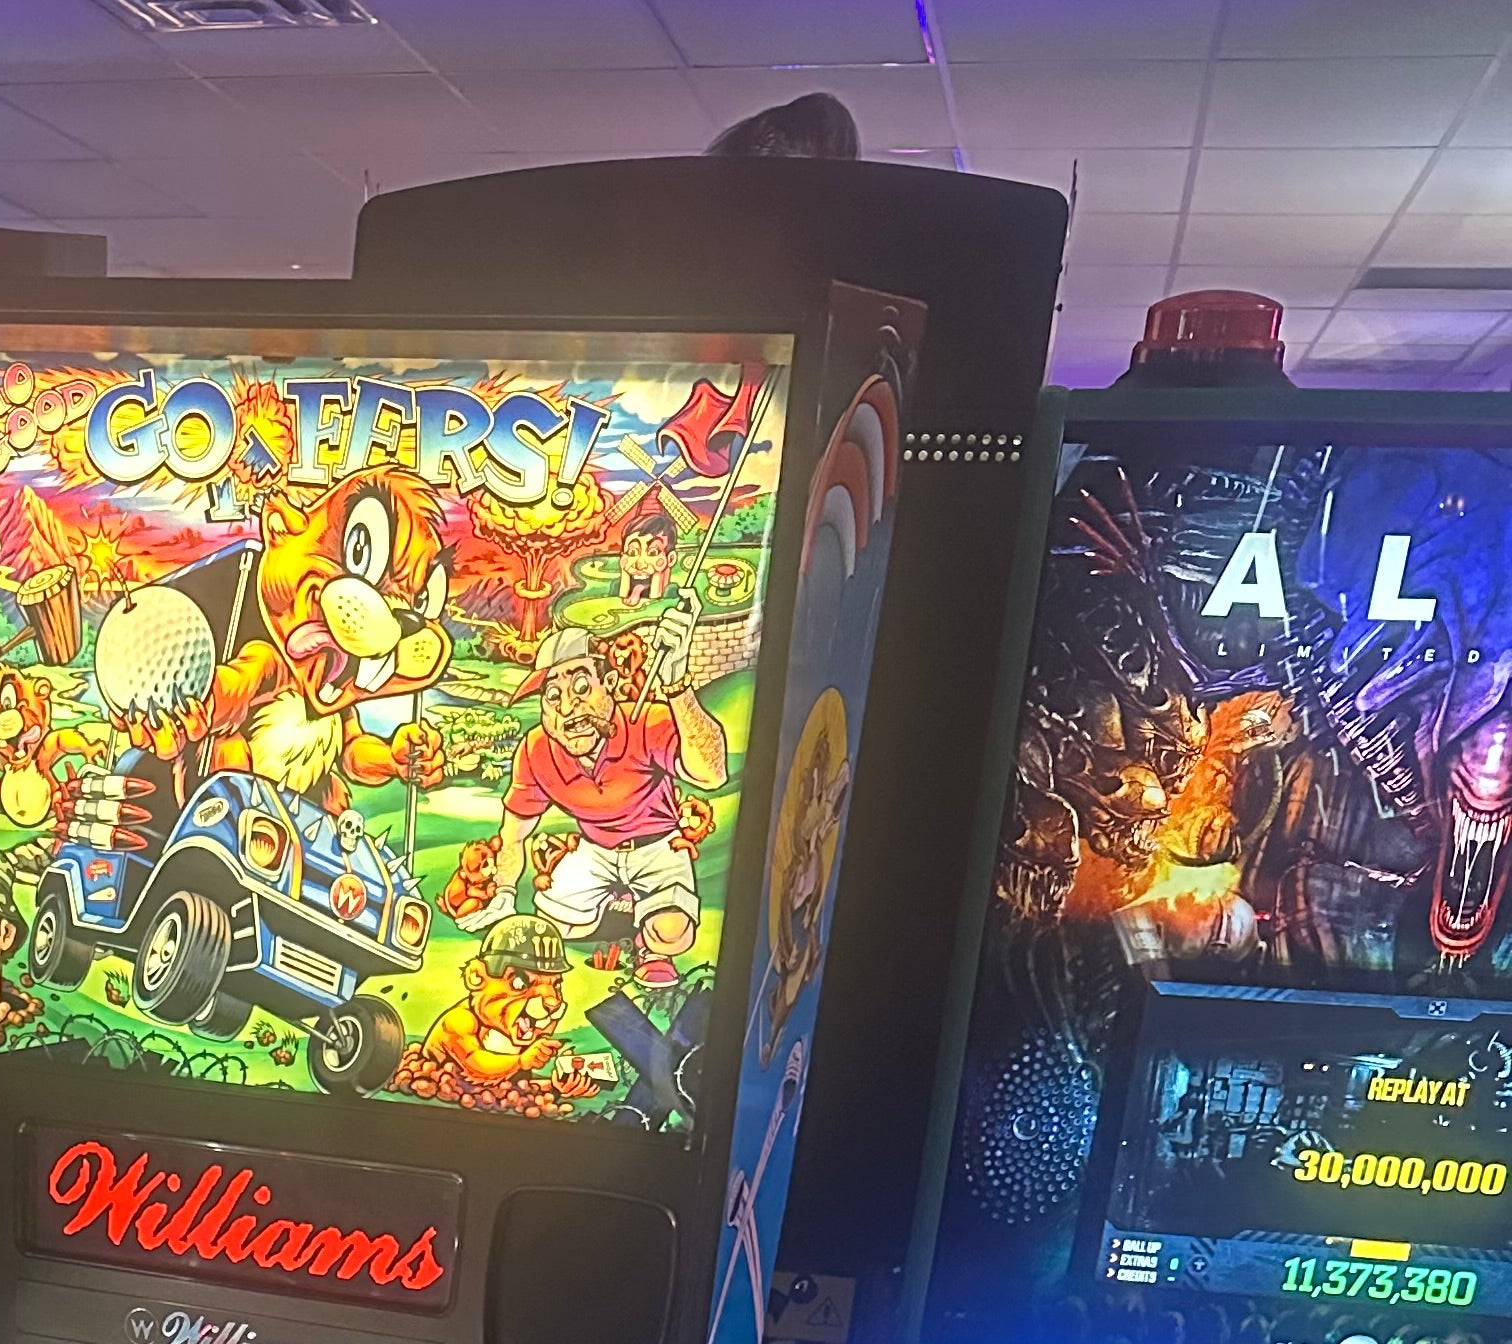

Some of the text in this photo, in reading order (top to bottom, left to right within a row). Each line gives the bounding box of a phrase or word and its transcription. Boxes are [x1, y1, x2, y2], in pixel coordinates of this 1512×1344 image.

[1367, 1078, 1472, 1107] REPLAY AT
[1293, 1149, 1508, 1196] 30,000,000
[48, 1140, 444, 1291] Williams
[1282, 1256, 1478, 1307] 11,373,380
